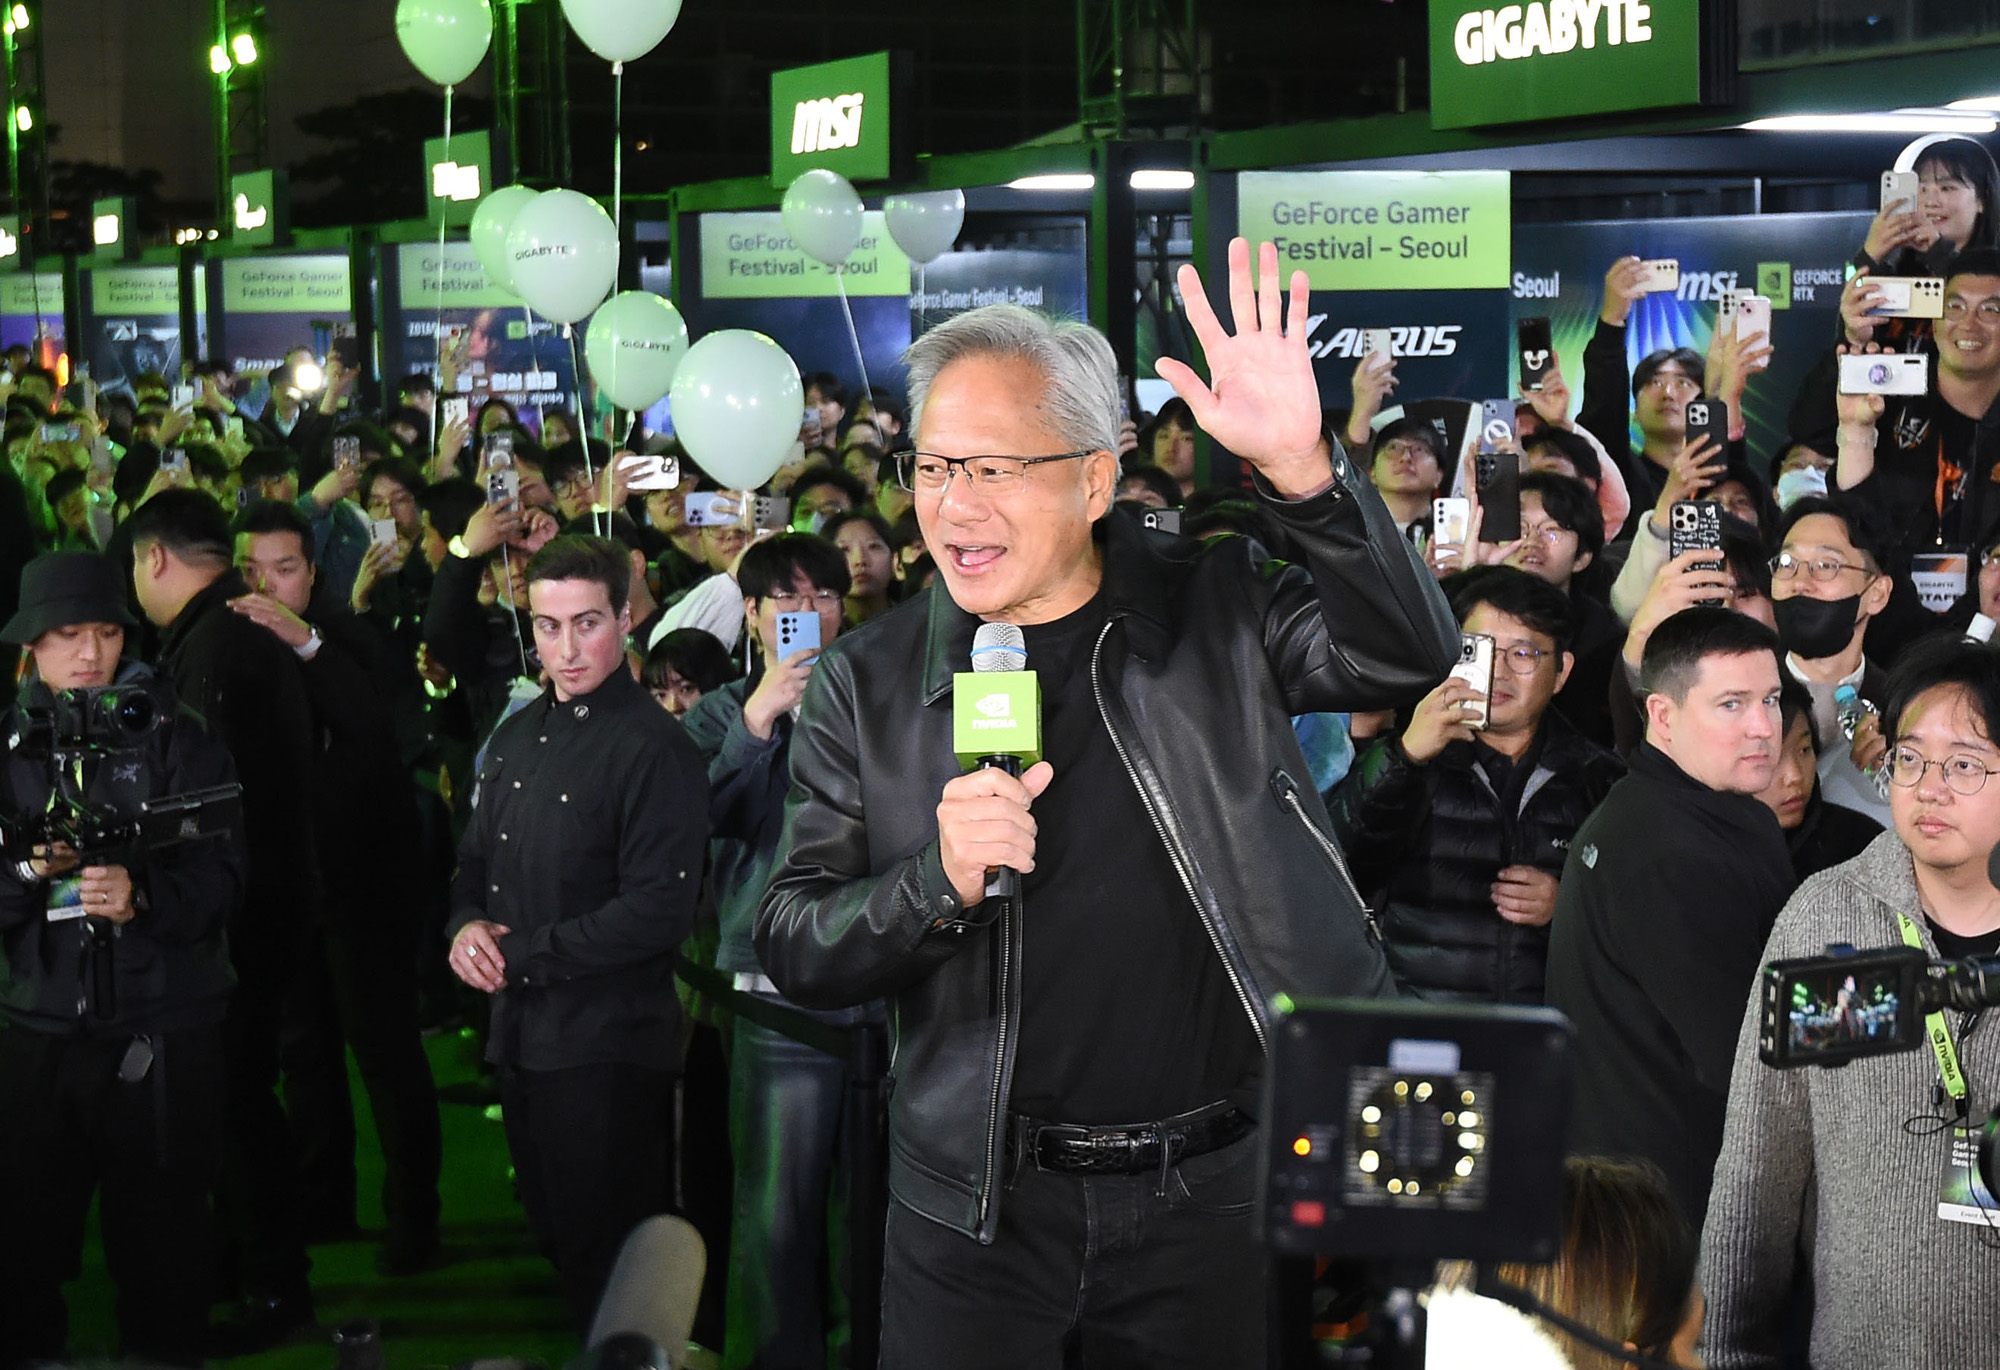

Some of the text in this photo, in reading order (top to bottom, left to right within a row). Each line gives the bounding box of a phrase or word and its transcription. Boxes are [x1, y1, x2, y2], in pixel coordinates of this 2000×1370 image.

[1454, 0, 1652, 65] GIGABYTE
[1273, 201, 1470, 225] GeForce Gamer
[728, 233, 798, 251] GeForc
[1274, 236, 1373, 260] Festival
[1399, 235, 1468, 258] Seoul
[515, 245, 570, 260] GIGABYTE
[729, 258, 805, 276] Festival
[422, 278, 484, 291] Festival
[1513, 271, 1560, 299] Seoul
[1793, 269, 1842, 285] GEFORCE
[1016, 286, 1043, 305] Seoul
[1793, 286, 1815, 302] RTX
[621, 340, 672, 352] GIGABYTE
[1938, 1044, 1956, 1082] NVIDIA
